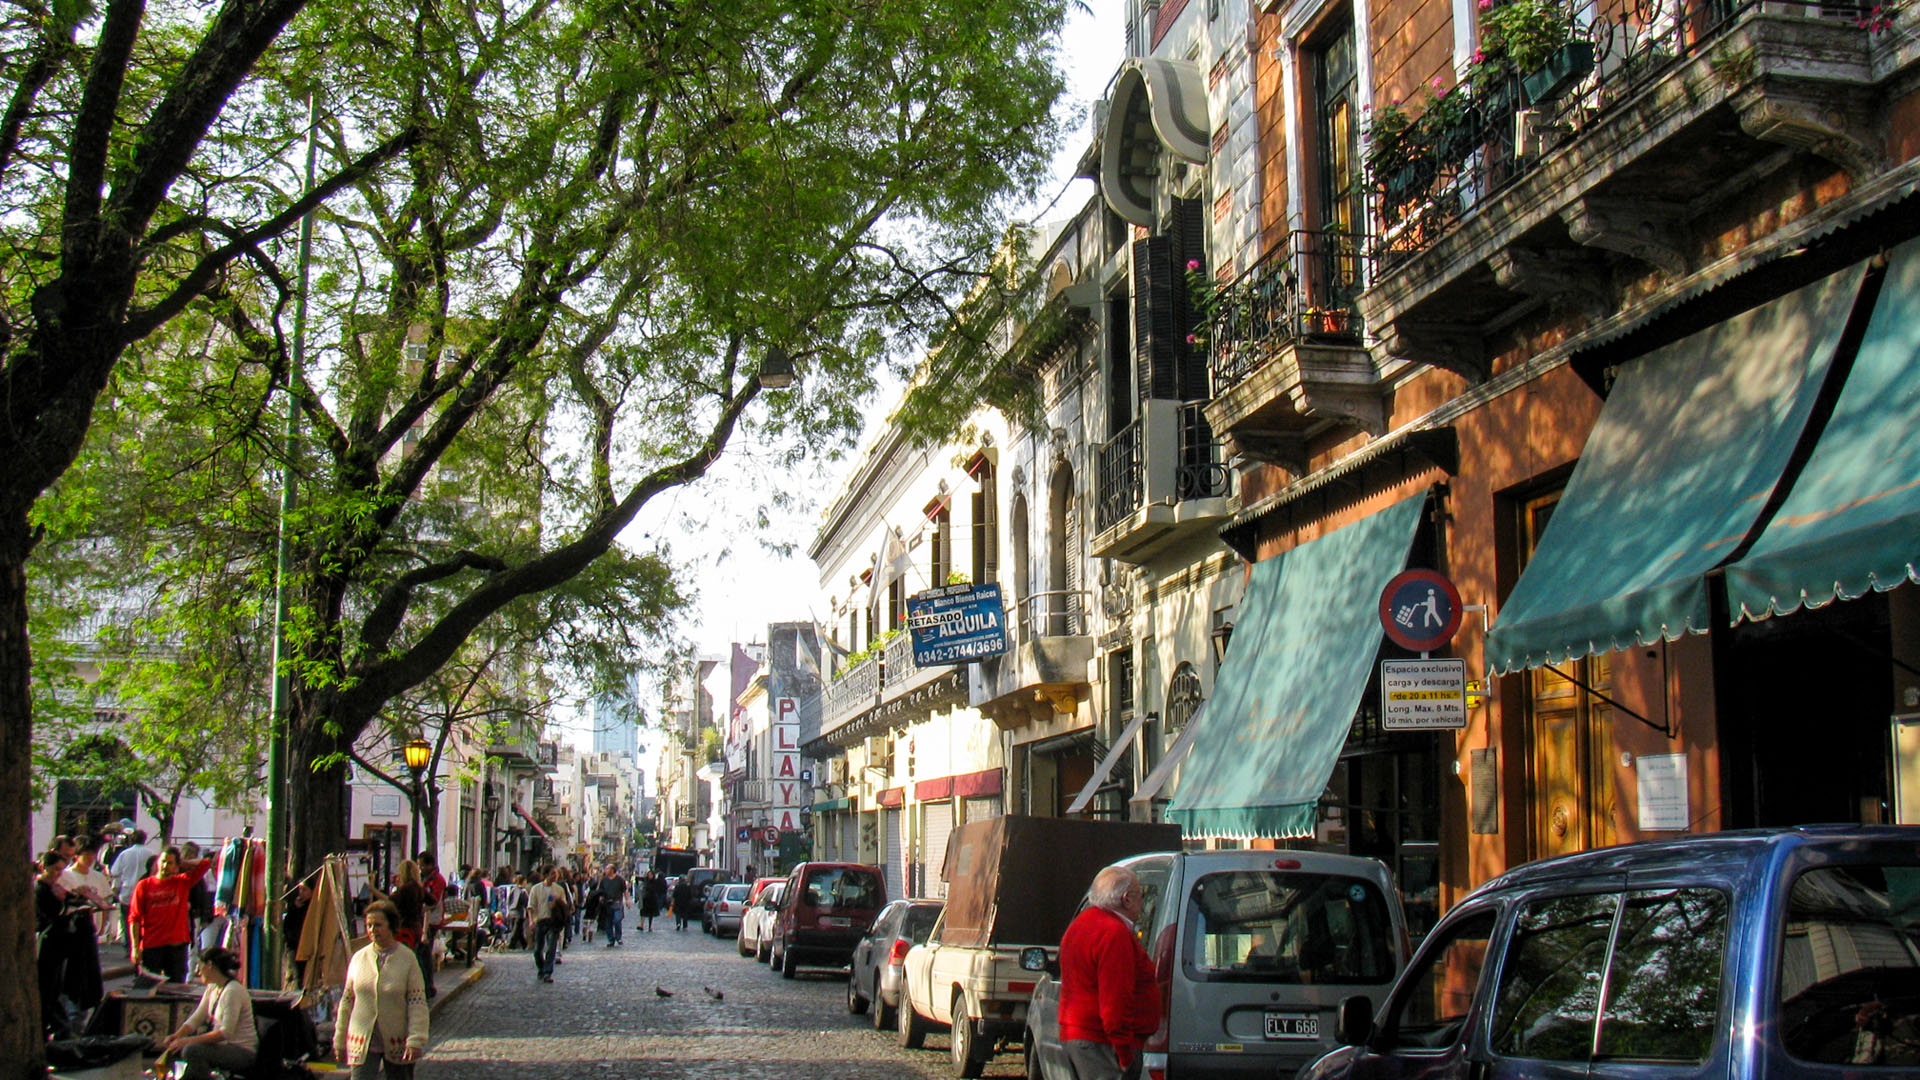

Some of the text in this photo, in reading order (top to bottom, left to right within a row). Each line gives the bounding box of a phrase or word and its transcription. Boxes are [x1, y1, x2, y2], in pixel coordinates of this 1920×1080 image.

[976, 589, 997, 600] Raices
[908, 611, 962, 628] RETASADO
[939, 612, 998, 638] ALQUILA
[917, 638, 1003, 664] 4342-2744/3696
[1386, 665, 1462, 674] Espacio exclusivo
[1388, 680, 1411, 688] carga
[1421, 679, 1460, 687] descarga
[1388, 706, 1412, 714] Long.
[1444, 704, 1462, 712] Mts.
[779, 699, 795, 830] PLAYA
[803, 771, 810, 779] E
[1267, 1019, 1317, 1034] FLY 668
